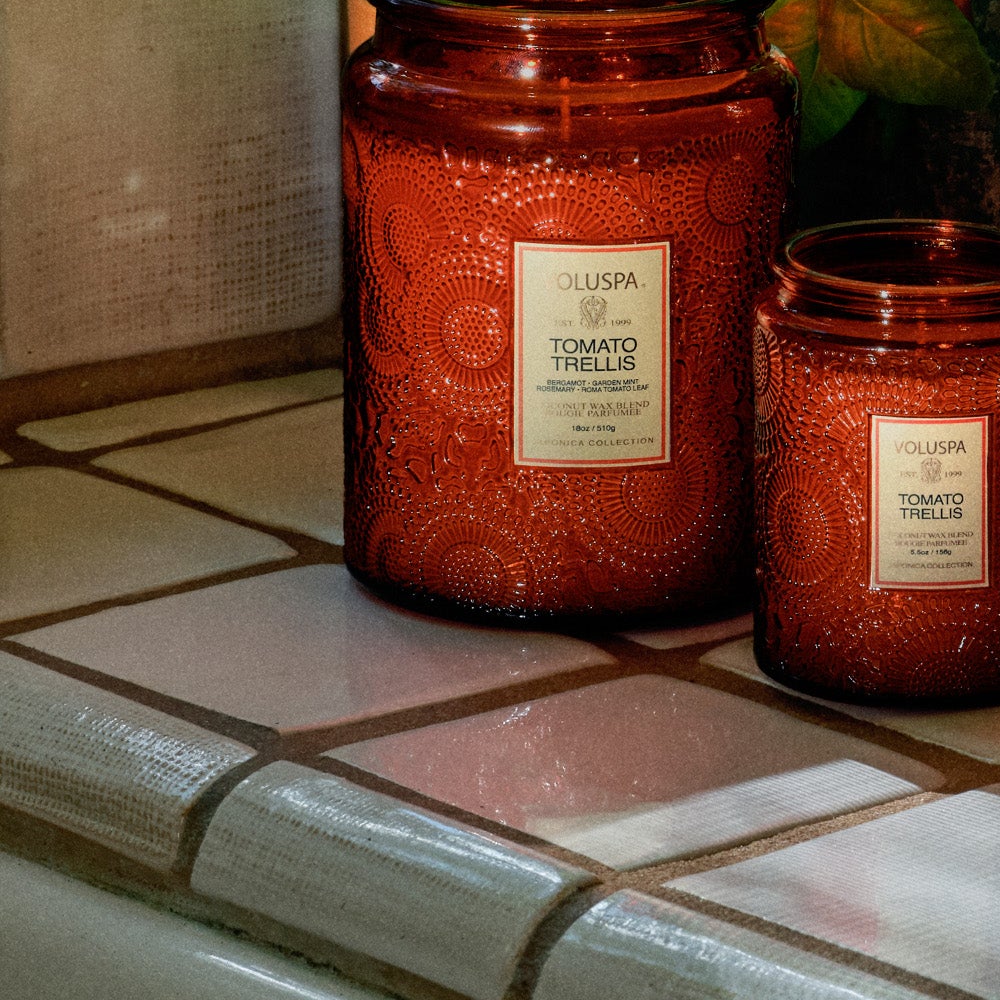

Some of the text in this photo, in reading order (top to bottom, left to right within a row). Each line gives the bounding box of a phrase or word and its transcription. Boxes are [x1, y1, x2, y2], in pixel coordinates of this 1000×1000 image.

[554, 272, 638, 290] OLUSPA
[549, 337, 637, 354] TOMATO
[551, 356, 635, 371] TRELLIS
[616, 400, 650, 408] BLEND
[597, 424, 616, 432] 510g
[588, 437, 654, 446] COLLECTION
[894, 440, 966, 455] VOLUSPA
[898, 493, 964, 505] TOMATO
[899, 507, 963, 520] TRELLIS
